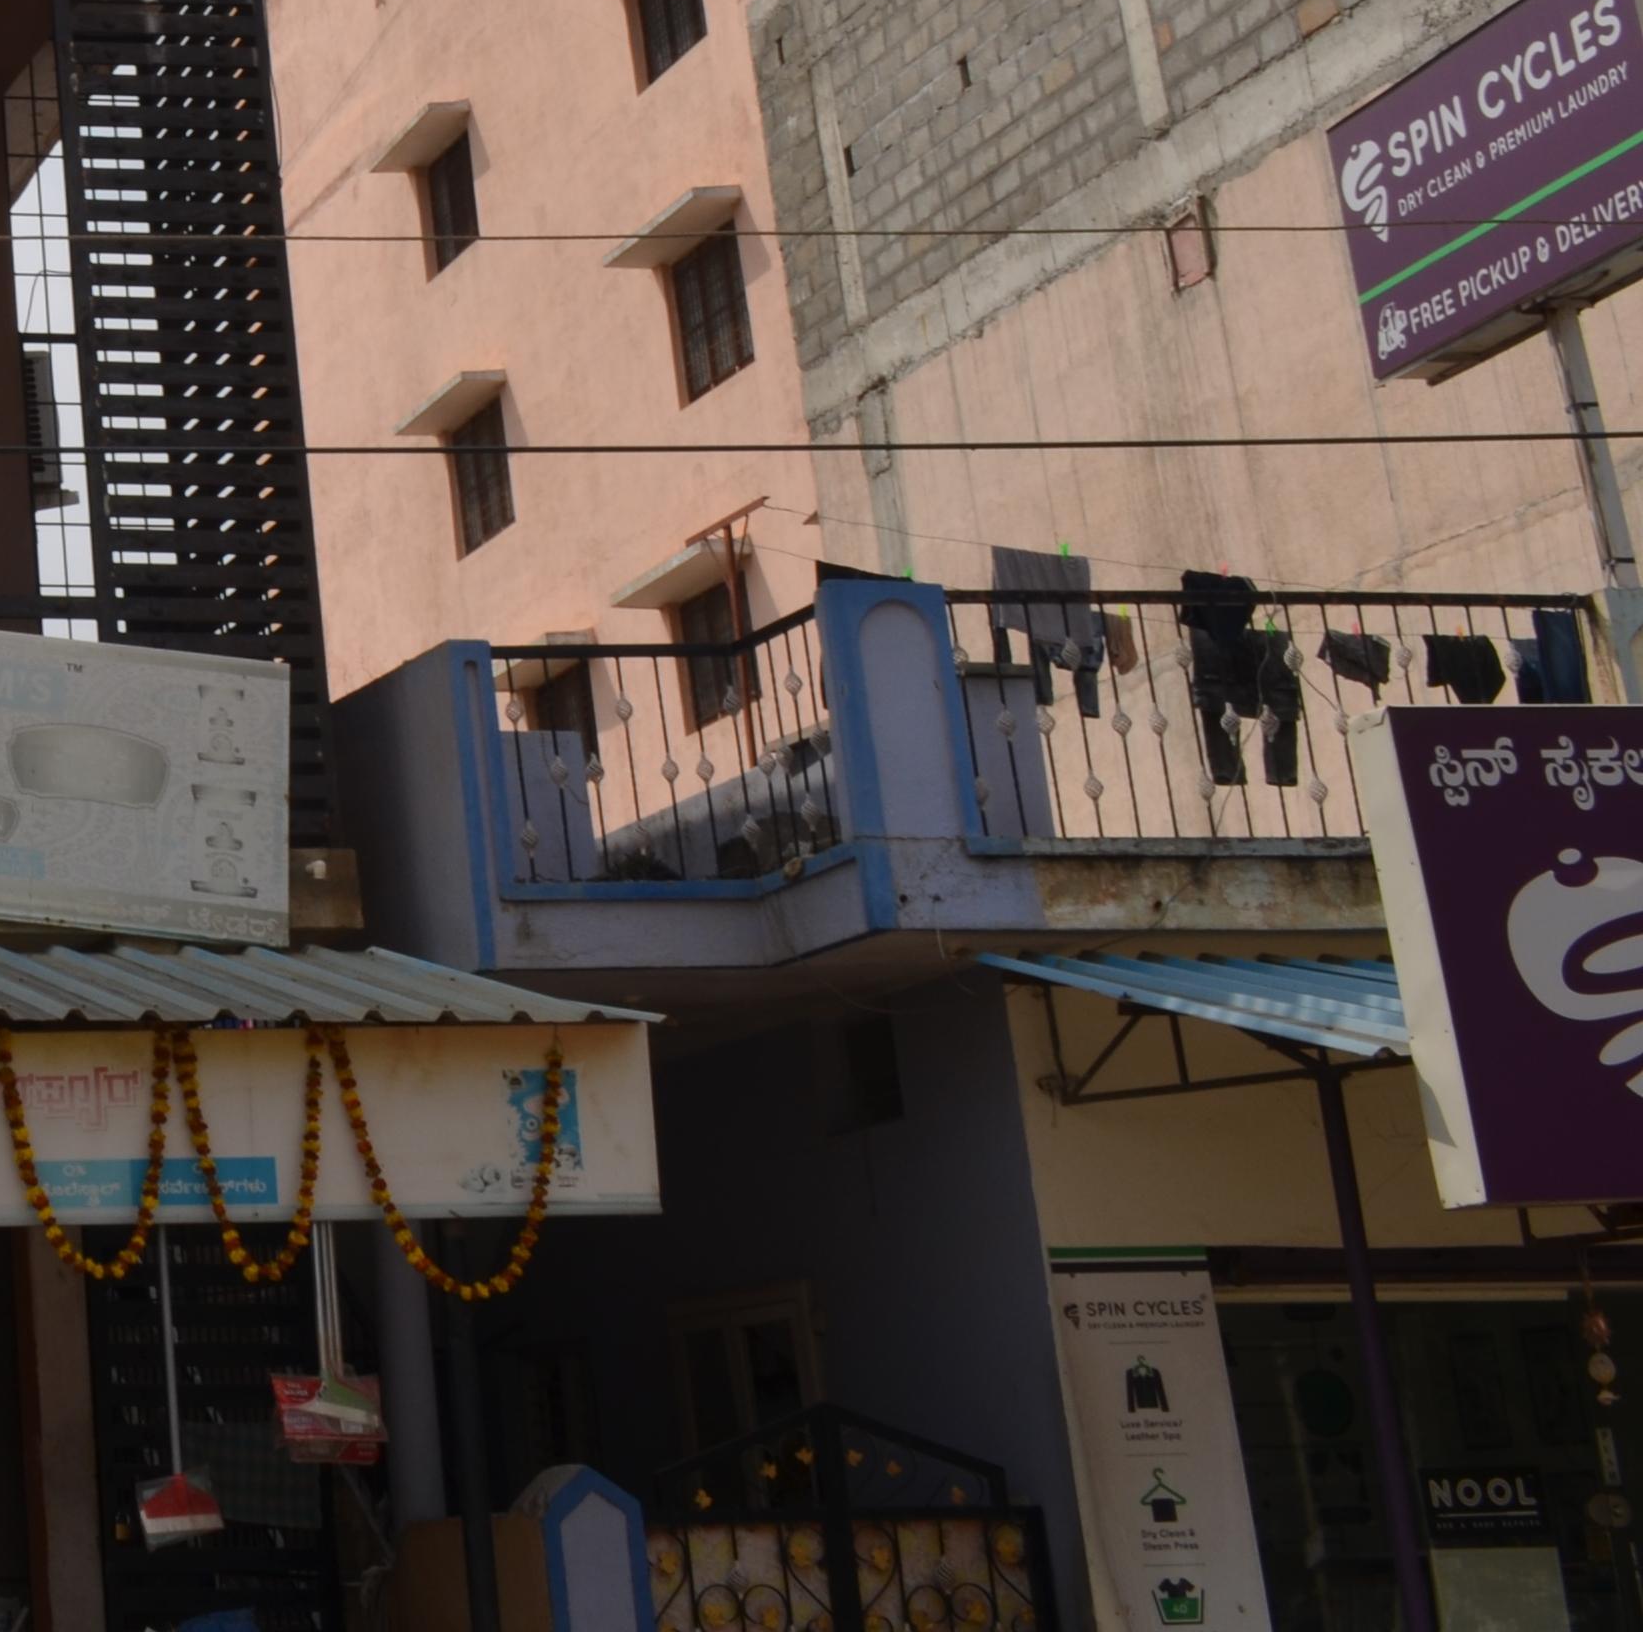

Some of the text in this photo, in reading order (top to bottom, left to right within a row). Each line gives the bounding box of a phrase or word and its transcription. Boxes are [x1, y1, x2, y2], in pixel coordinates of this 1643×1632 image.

[1387, 95, 1467, 177] SPIN
[1397, 61, 1630, 219] DRY CLEAN & PREMIUM LAUNDRY
[1409, 286, 1457, 335] FREE
[1458, 245, 1531, 304] PICKUP
[1535, 235, 1551, 265] &
[1428, 736, 1519, 808] ಸ್ಪಿನ್
[1085, 1299, 1205, 1317] SPIN CYCLES
[1427, 1476, 1539, 1509] NOOL
[1159, 1527, 1186, 1538] Clean
[1173, 1540, 1200, 1551] Press
